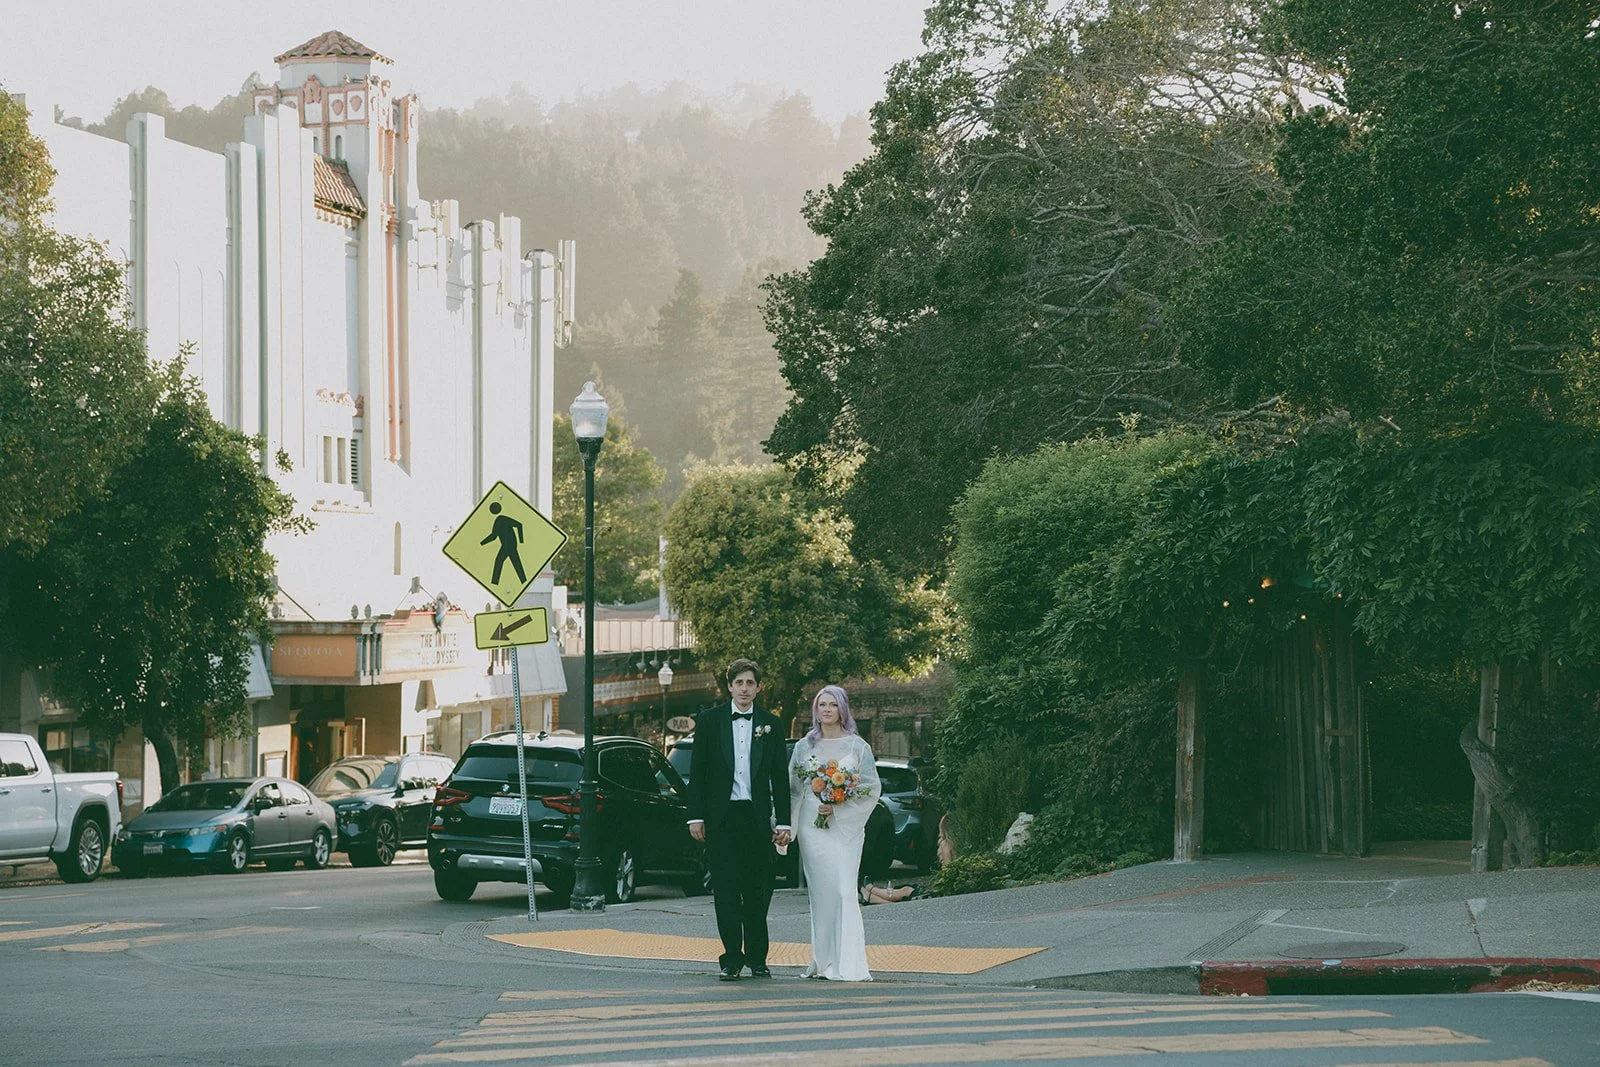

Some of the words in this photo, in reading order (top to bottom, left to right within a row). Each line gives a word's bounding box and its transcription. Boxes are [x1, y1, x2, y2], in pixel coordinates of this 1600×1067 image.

[420, 634, 432, 648] THE
[279, 646, 344, 657] SEQUOIA
[673, 719, 690, 730] PLAYA
